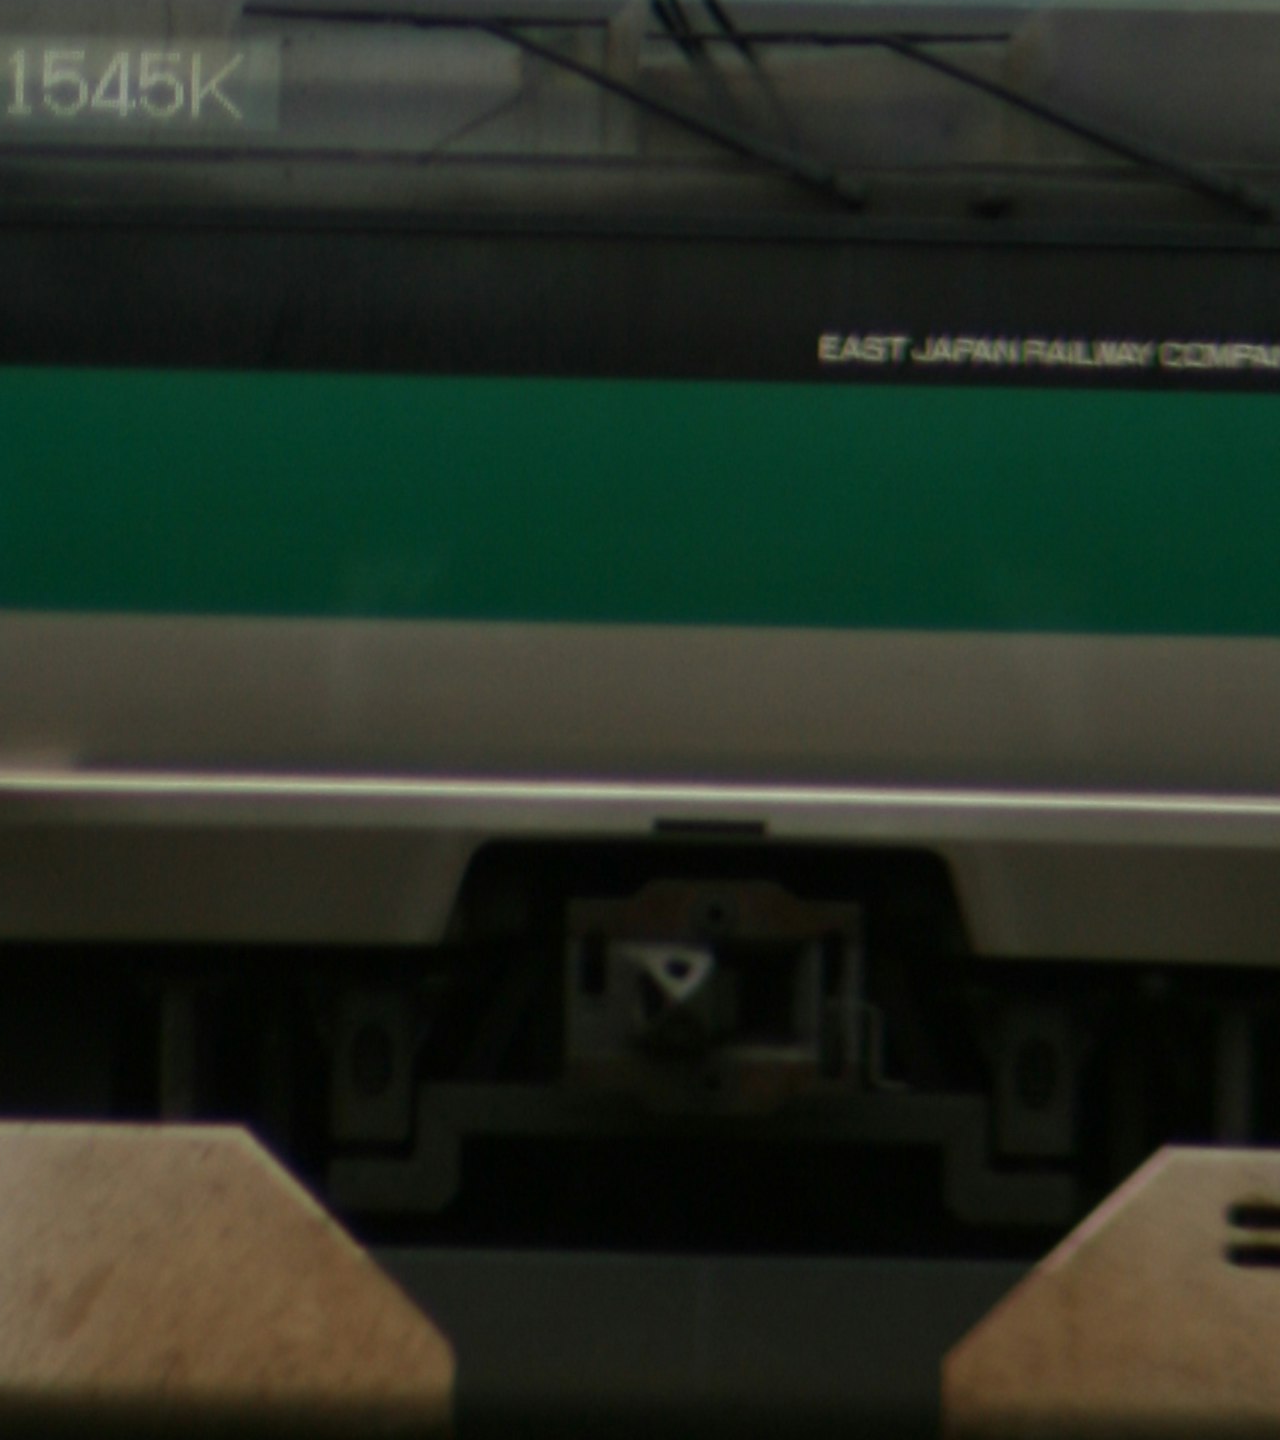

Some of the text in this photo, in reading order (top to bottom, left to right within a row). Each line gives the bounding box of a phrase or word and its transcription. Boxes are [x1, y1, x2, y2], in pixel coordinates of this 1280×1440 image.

[6, 46, 244, 122] 1545K
[818, 333, 910, 363] EAST
[911, 335, 1017, 366] JAPAN
[1020, 338, 1154, 368] RAILWAY
